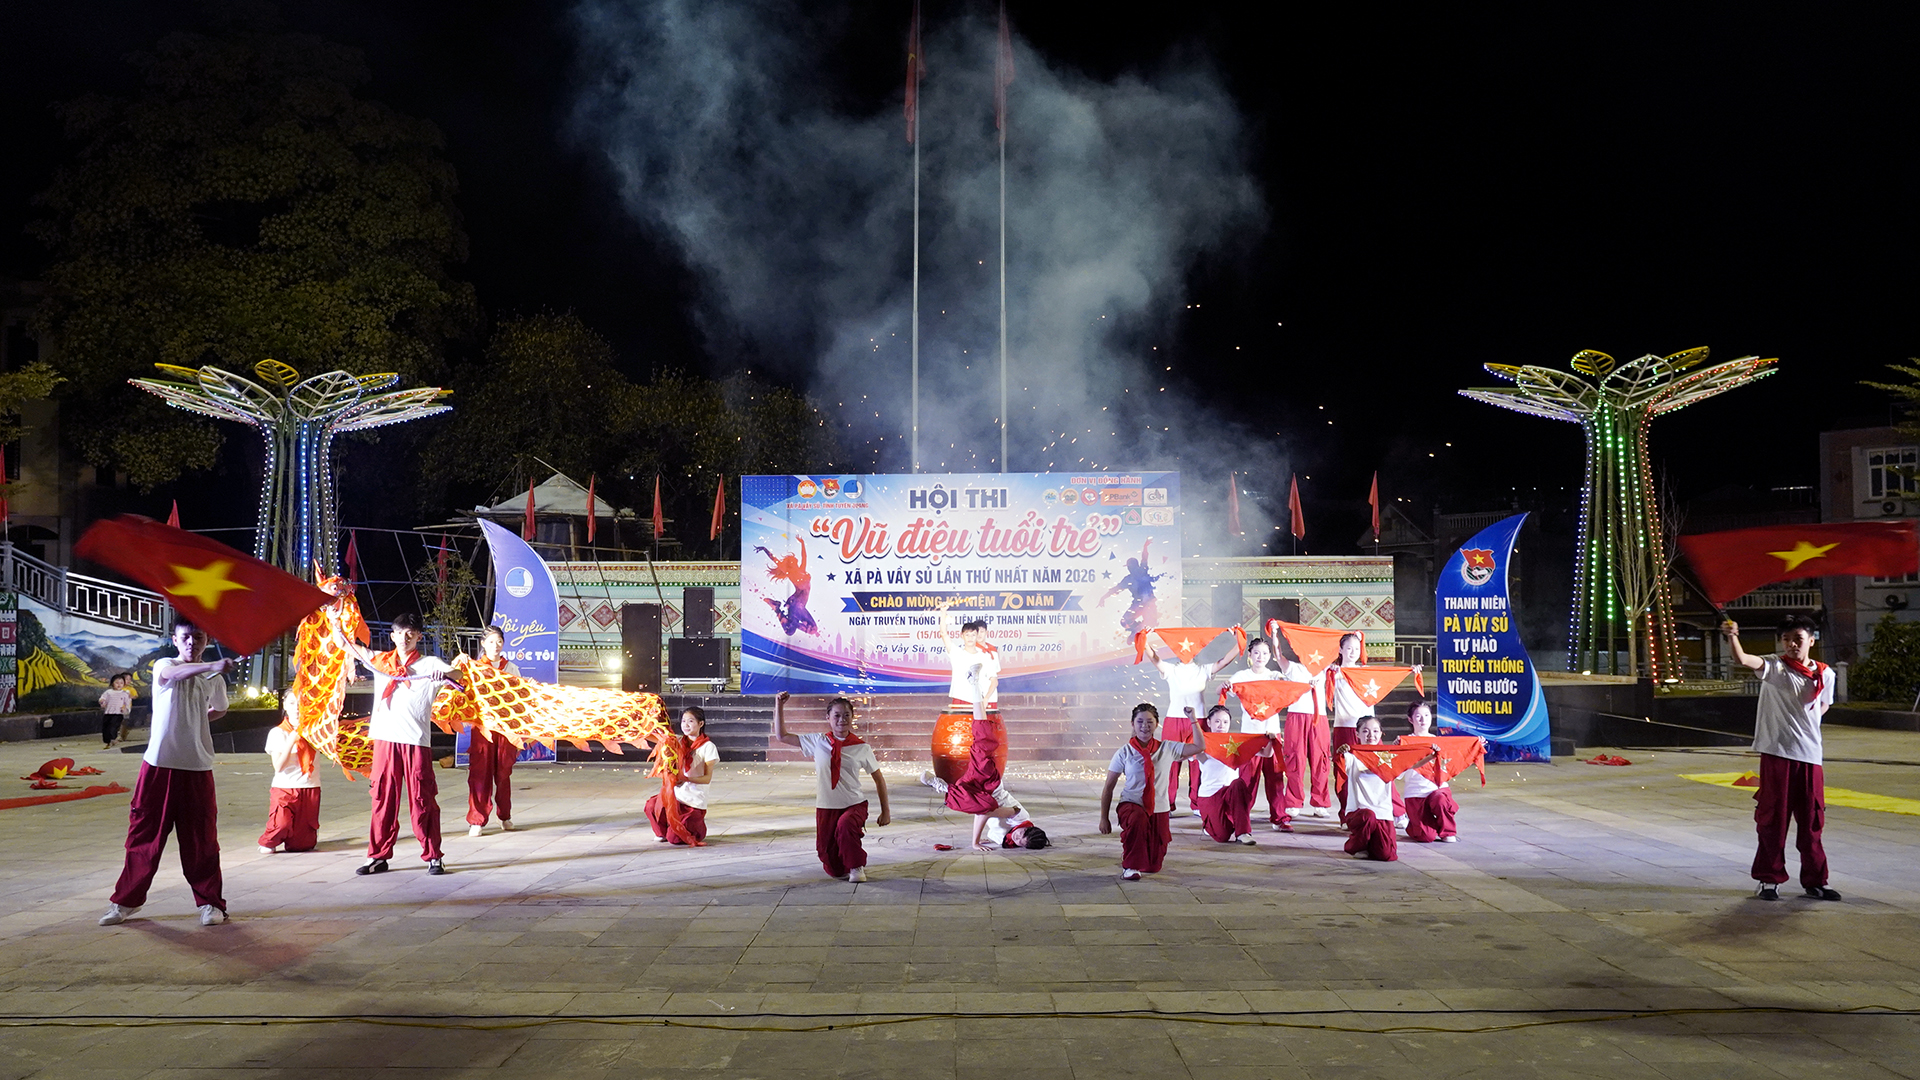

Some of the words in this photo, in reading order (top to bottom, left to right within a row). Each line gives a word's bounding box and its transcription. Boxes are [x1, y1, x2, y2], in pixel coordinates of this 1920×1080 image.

[910, 484, 957, 515] HỘI
[965, 488, 1007, 509] THI
[897, 517, 971, 562] điệu
[980, 511, 1044, 554] tuổi
[844, 567, 862, 585] XÃ
[866, 567, 883, 585] PÀ
[887, 566, 911, 585] VẦY
[915, 566, 933, 584] SỦ
[937, 566, 961, 584] LẦN
[966, 566, 991, 584] THỨ
[995, 565, 1028, 584] NHẤT
[1033, 566, 1061, 583] NĂM
[1065, 568, 1096, 583] 2026
[870, 594, 903, 608] CHÀO
[906, 595, 942, 608] MỪNG
[965, 593, 996, 610] NIỆM
[999, 592, 1024, 610] 70
[1026, 593, 1054, 607] NĂM
[1444, 597, 1479, 610] THANH
[1481, 595, 1507, 610] NIÊN
[849, 614, 871, 626] NGÀY
[873, 613, 905, 626] TRUYỀN
[908, 613, 936, 626] THỐNG
[955, 613, 973, 625] LIÊN
[996, 615, 1025, 625] THANH
[1027, 613, 1046, 624] NIÊN
[1048, 613, 1068, 626] VIỆT
[1069, 614, 1088, 624] NAM
[1443, 613, 1461, 633] PÀ
[1464, 611, 1488, 633] VẦY
[1491, 611, 1509, 633] SỦ
[510, 619, 556, 647] yêu
[535, 649, 555, 661] TÔI
[1002, 643, 1013, 652] 10
[1015, 643, 1036, 652] năm
[1040, 643, 1062, 652] 2026
[1453, 637, 1470, 656] TỰ
[1472, 636, 1498, 653] HÀO
[1441, 655, 1485, 673] TRUYỀN
[1487, 656, 1525, 673] THỐNG
[1447, 677, 1481, 694] VỮNG
[1484, 678, 1518, 694] BƯỚC
[1456, 699, 1492, 714] TƯƠNG
[1495, 701, 1513, 715] LAI
